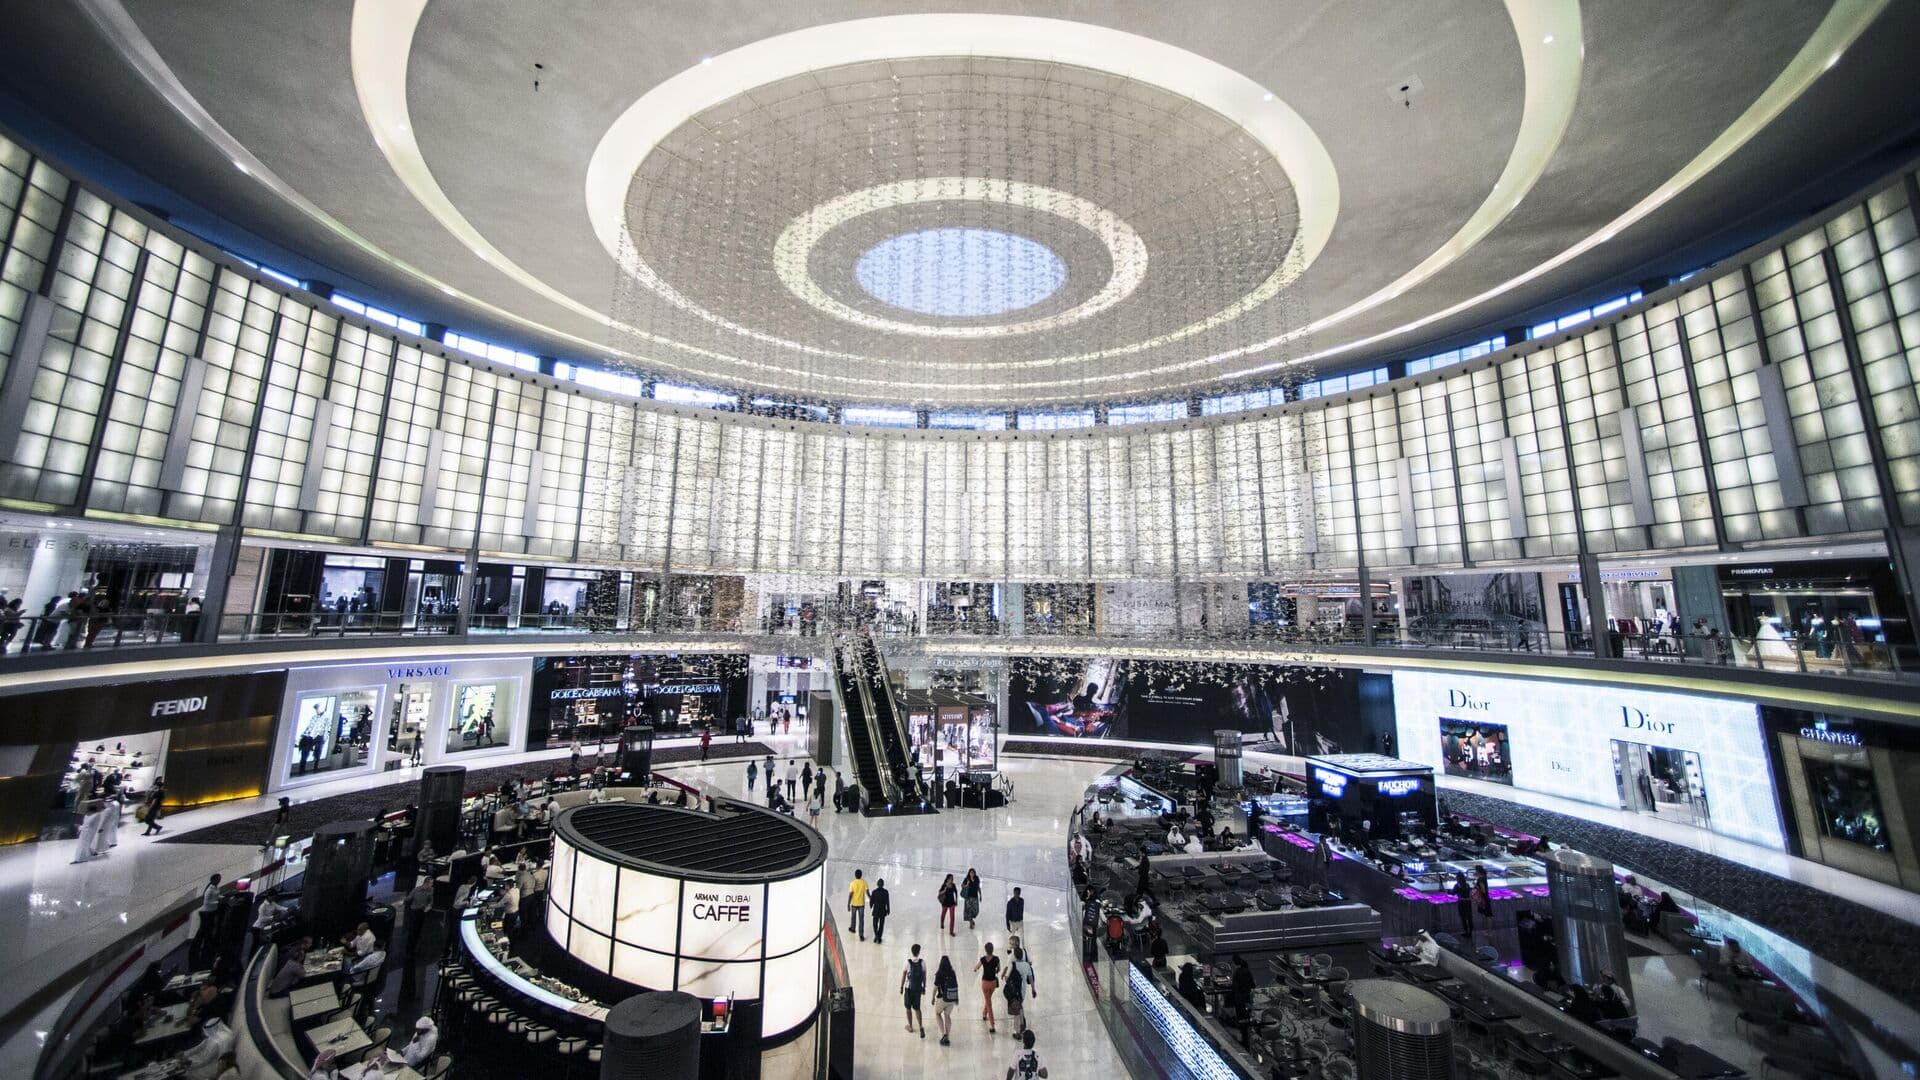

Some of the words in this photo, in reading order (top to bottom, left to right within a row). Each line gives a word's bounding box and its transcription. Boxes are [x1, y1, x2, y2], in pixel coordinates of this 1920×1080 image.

[388, 666, 449, 679] VERSACE
[151, 696, 208, 716] FENDI
[1448, 689, 1491, 711] Dior
[1620, 705, 1676, 734] Dior
[1800, 727, 1862, 747] CHANEL
[1378, 779, 1419, 793] FAUCHON
[694, 892, 719, 902] ARMANI
[725, 894, 751, 903] DUBAI
